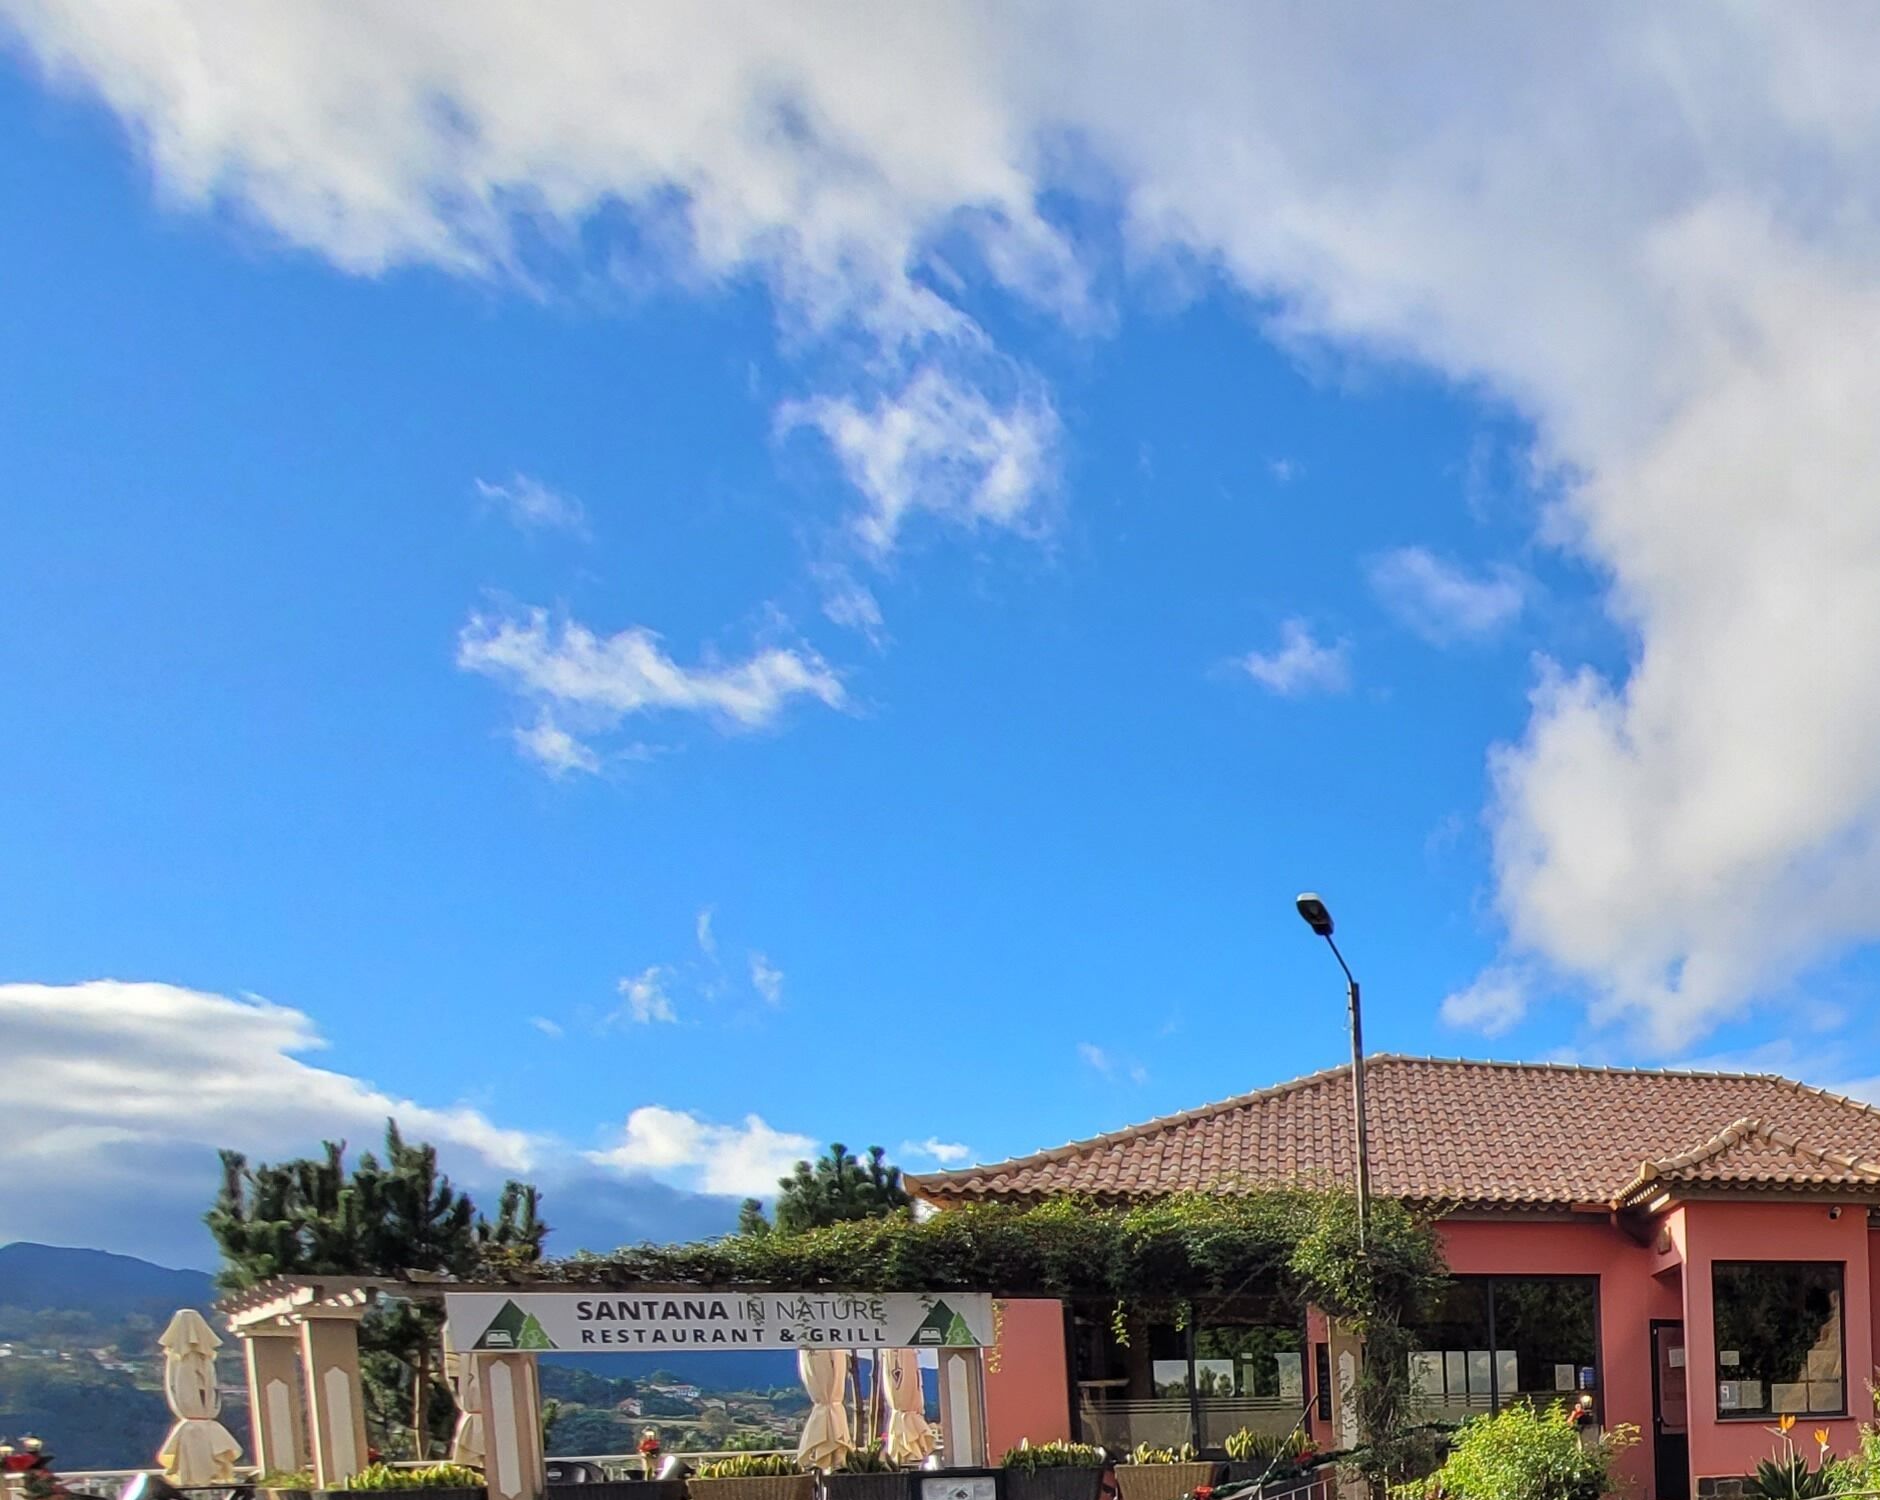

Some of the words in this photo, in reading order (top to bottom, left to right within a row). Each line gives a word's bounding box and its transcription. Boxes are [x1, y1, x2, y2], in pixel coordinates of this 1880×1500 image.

[576, 1300, 730, 1321] SANTANA
[738, 1300, 766, 1321] IN
[776, 1300, 884, 1321] NATURE
[581, 1328, 765, 1344] RESTAURANT
[779, 1327, 795, 1342] &
[810, 1327, 886, 1342] GRILL
